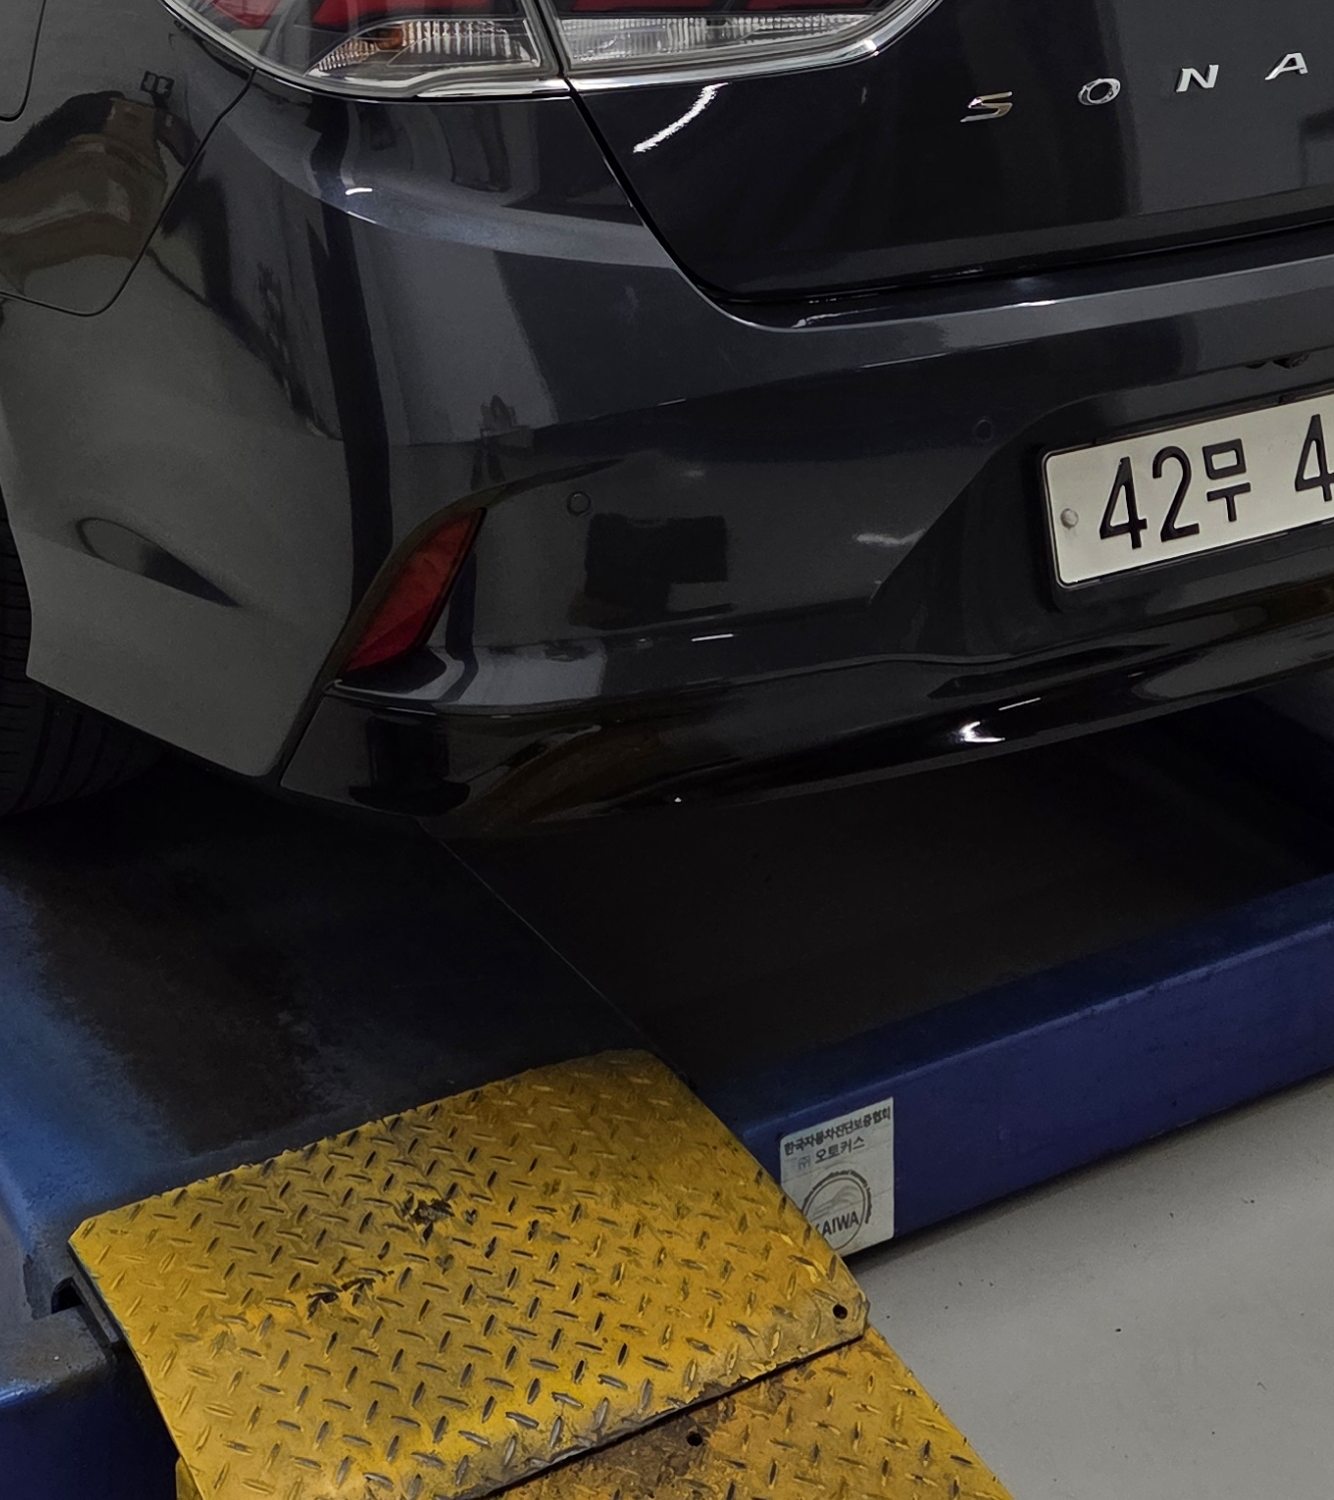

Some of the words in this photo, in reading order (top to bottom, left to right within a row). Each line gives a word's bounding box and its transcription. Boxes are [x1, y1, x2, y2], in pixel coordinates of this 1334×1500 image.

[1099, 437, 1252, 550] 42무
[815, 1136, 866, 1164] 오토커스
[815, 1211, 860, 1237] AIWA
